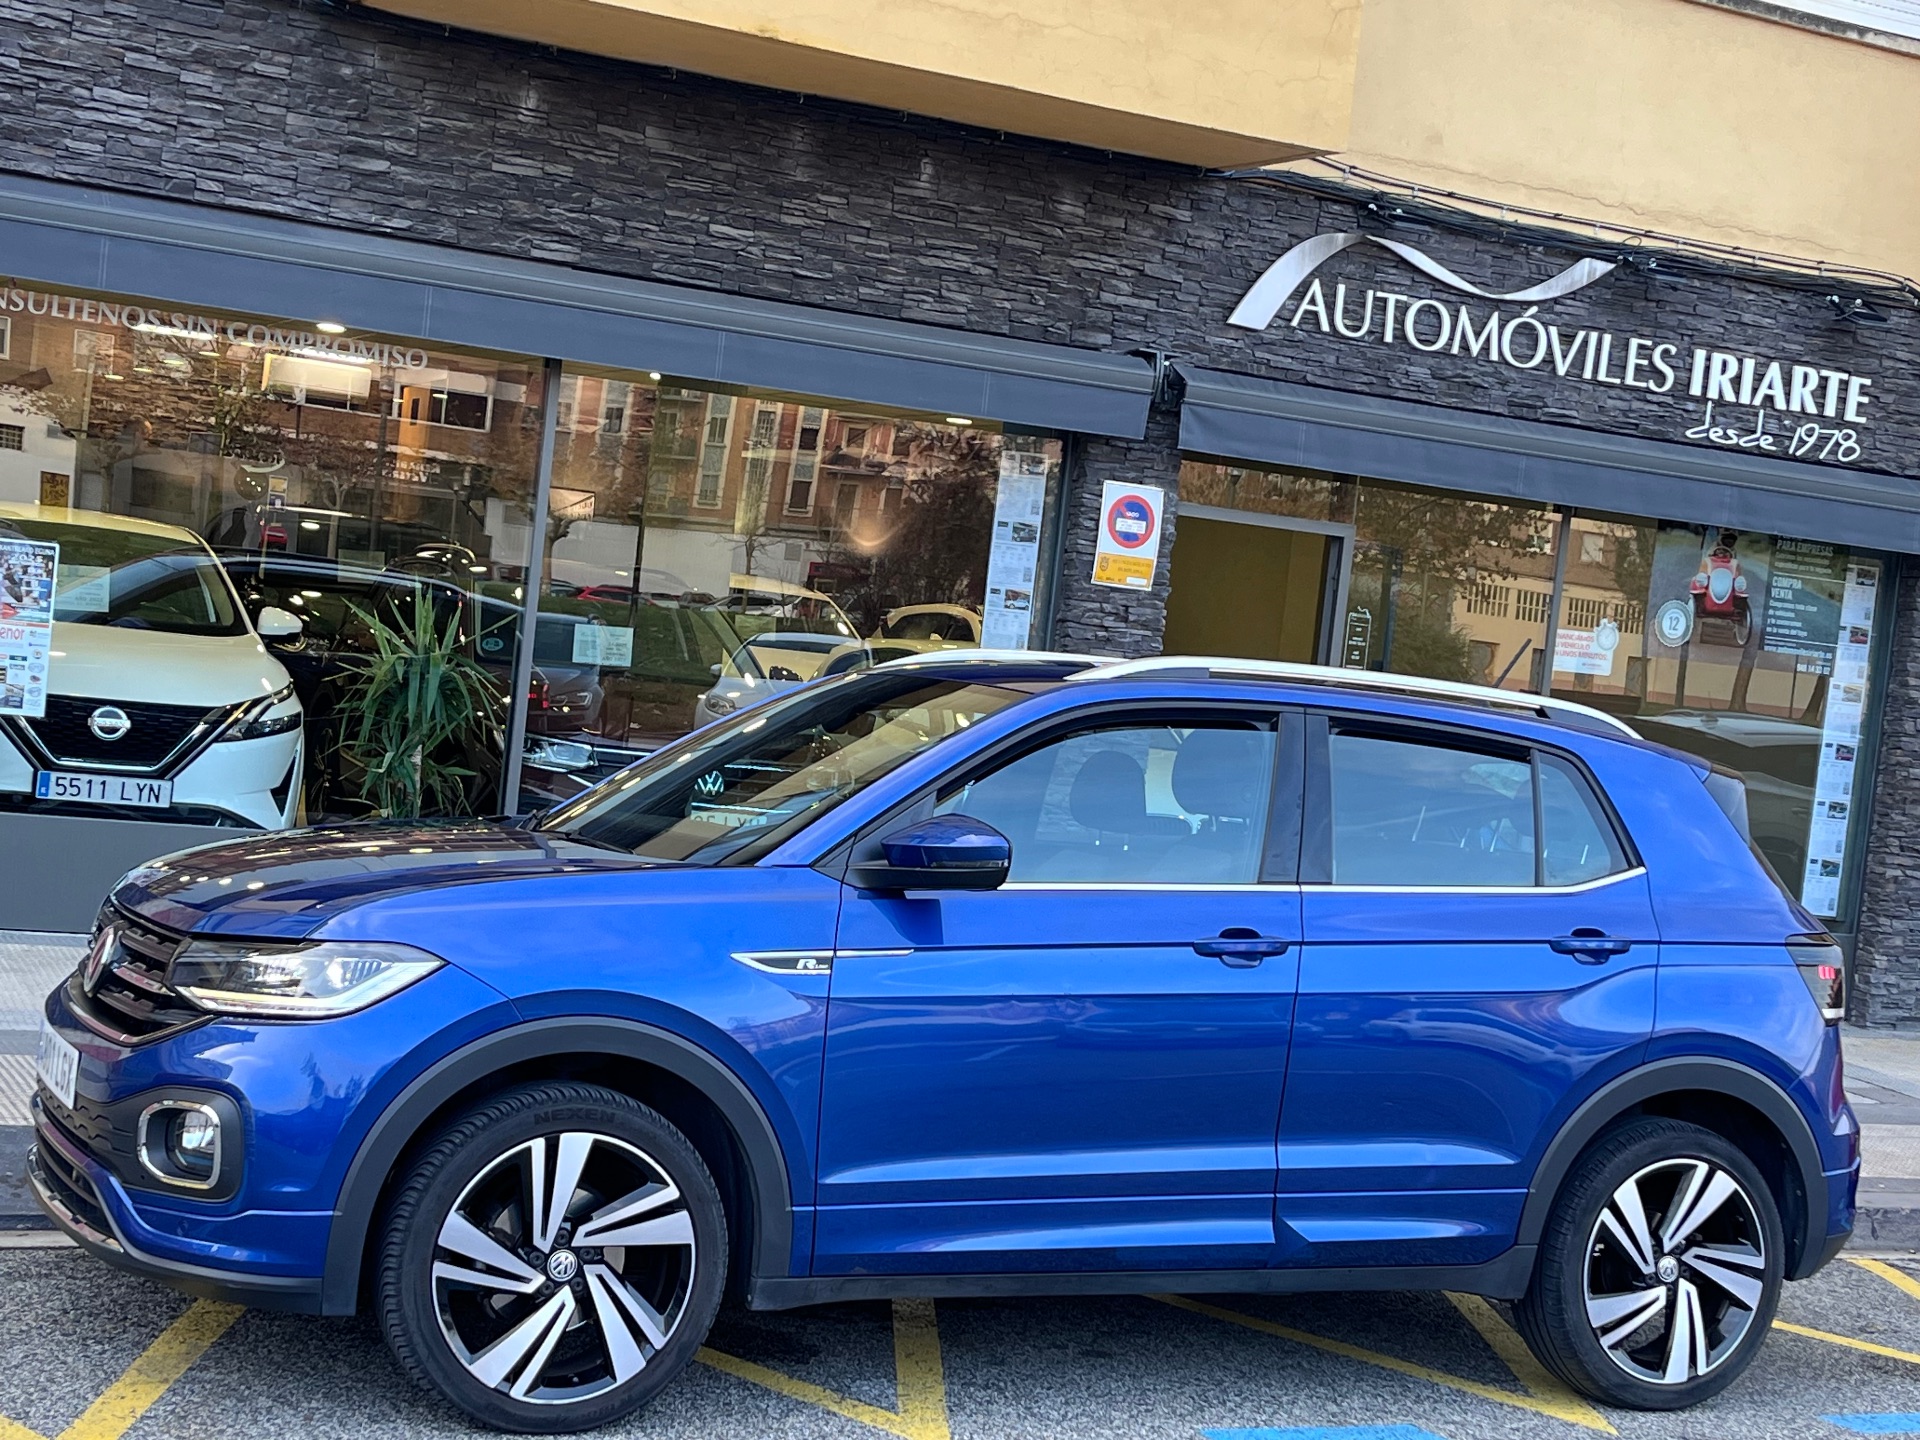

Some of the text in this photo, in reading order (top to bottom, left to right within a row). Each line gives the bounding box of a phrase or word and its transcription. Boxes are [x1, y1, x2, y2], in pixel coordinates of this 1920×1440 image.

[227, 321, 428, 371] COMPROMISO
[1291, 278, 1872, 423] AUTOMÓVILES IRIARTE
[1685, 400, 1861, 462] desde 1978
[1771, 587, 1793, 600] VENTA
[1773, 576, 1802, 590] COMPRA
[1669, 616, 1680, 631] 12
[55, 776, 162, 804] 5511 LYN
[534, 1107, 616, 1125] NEXEN
